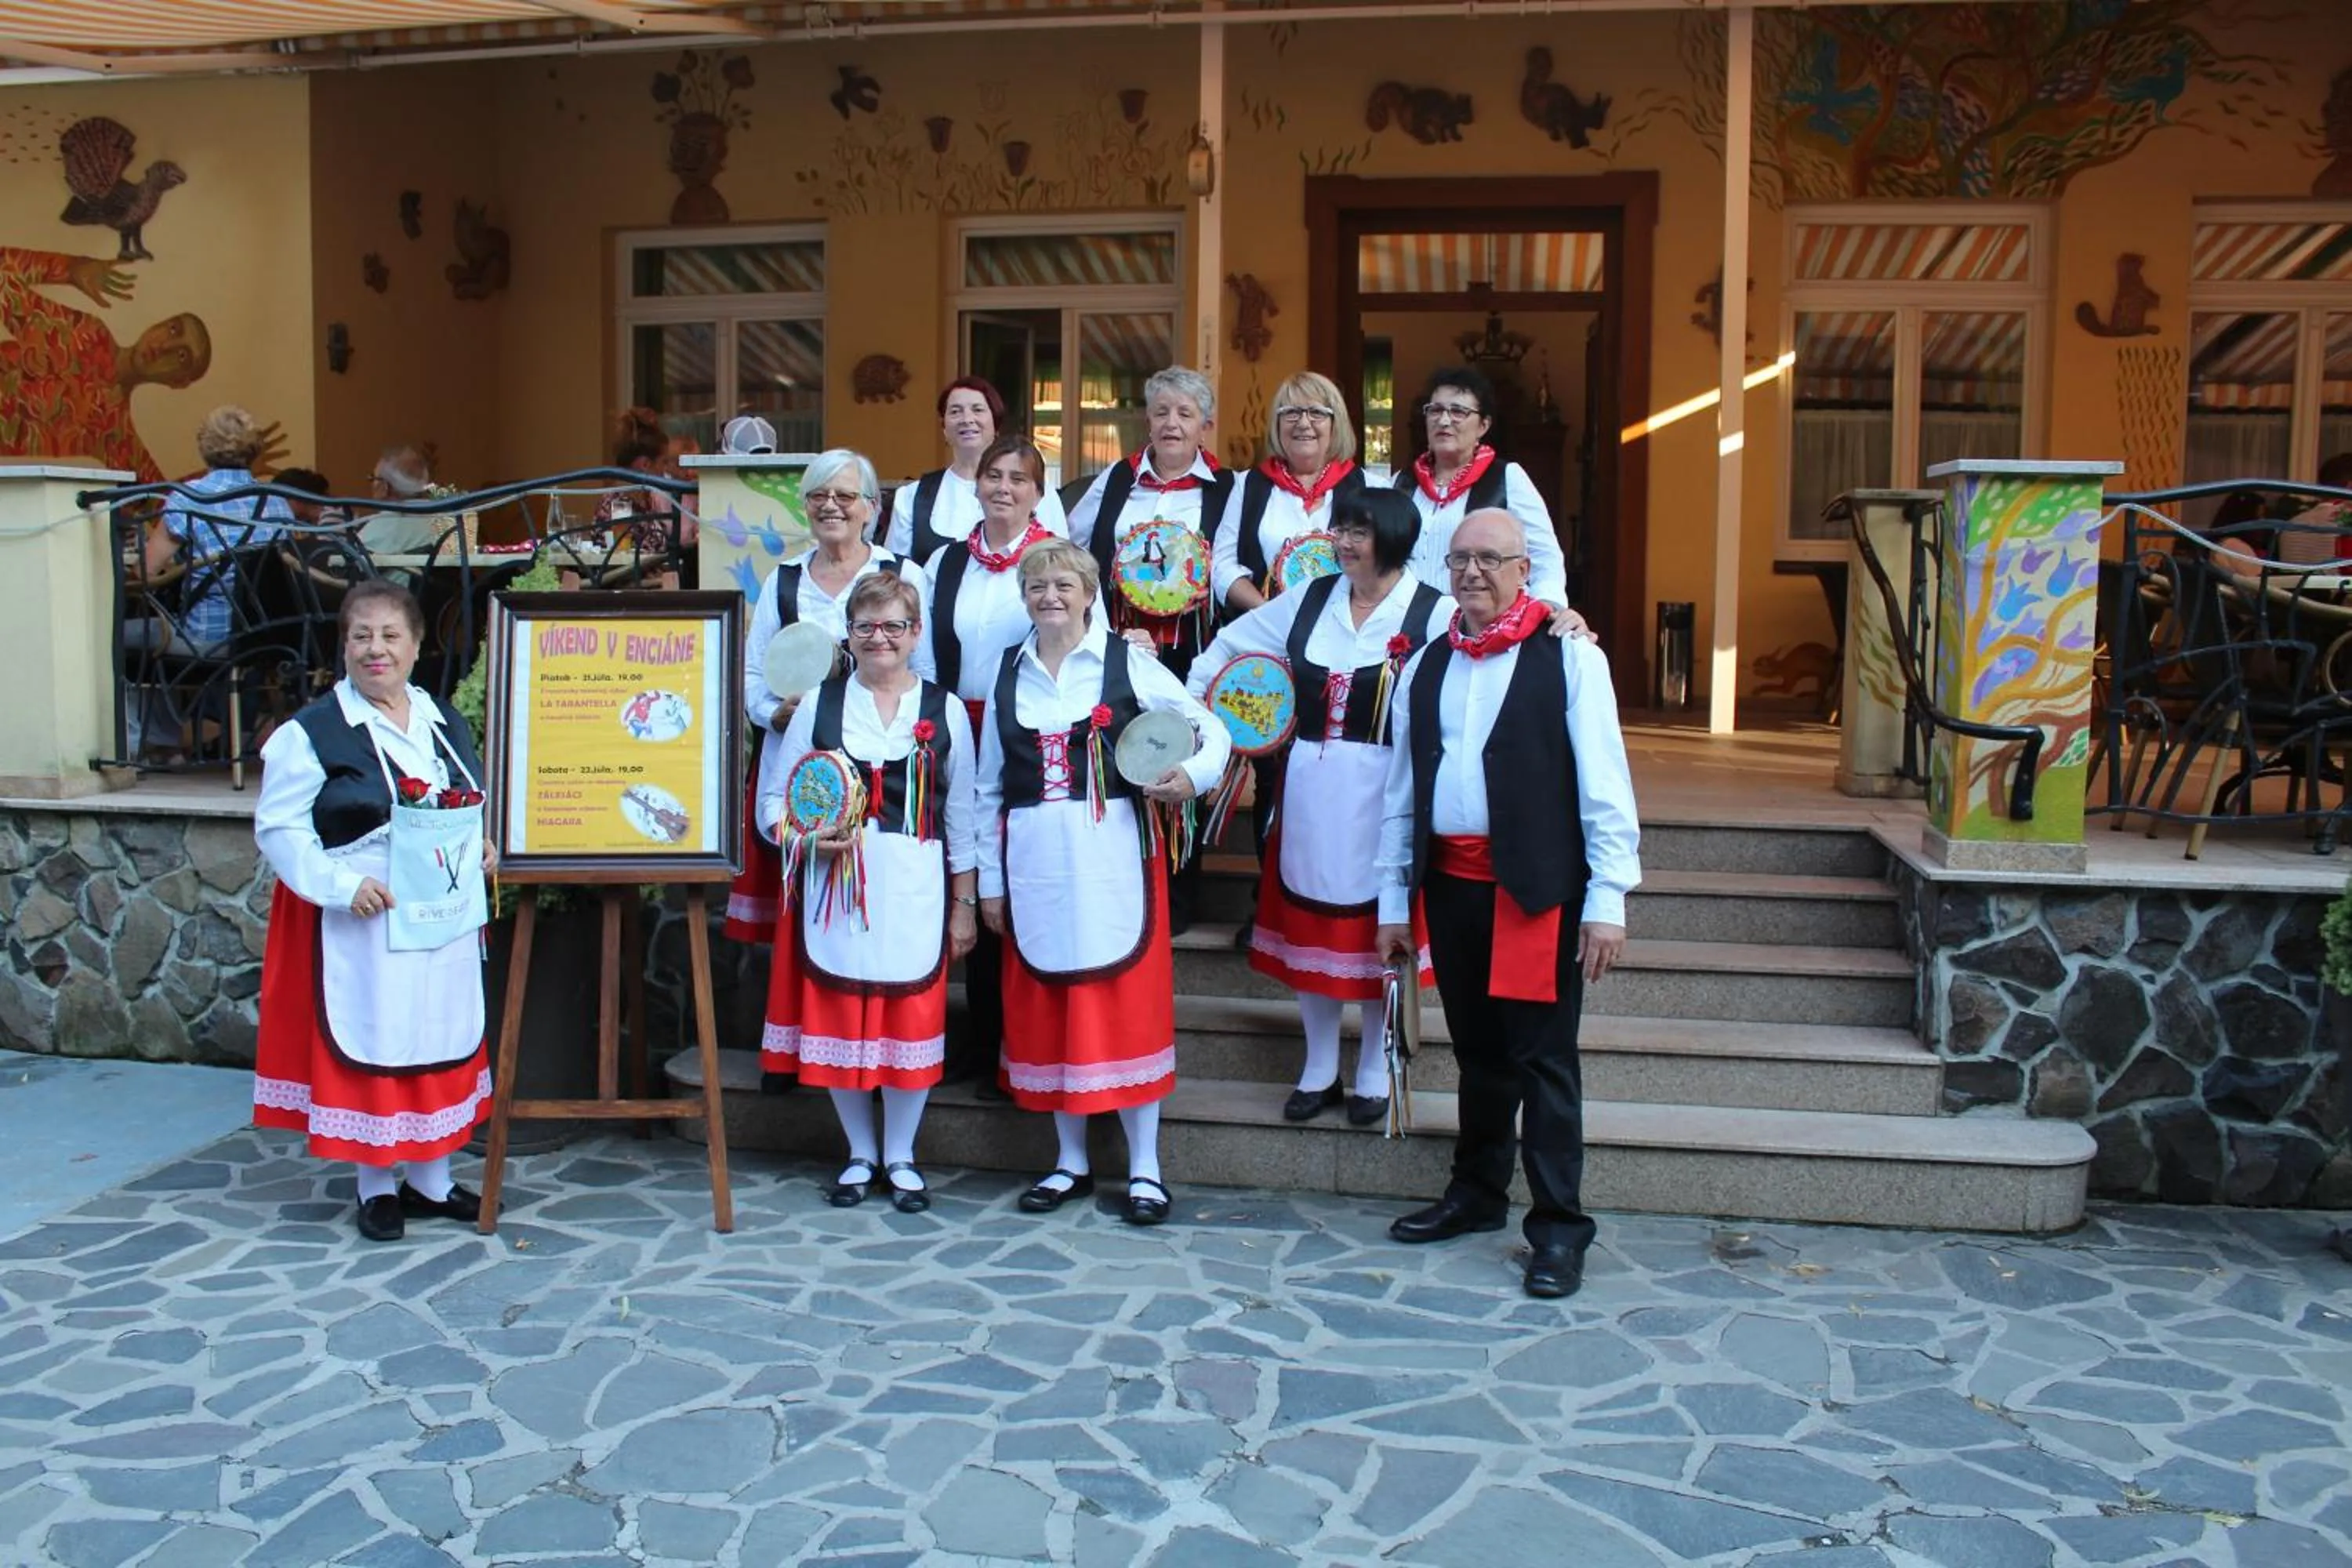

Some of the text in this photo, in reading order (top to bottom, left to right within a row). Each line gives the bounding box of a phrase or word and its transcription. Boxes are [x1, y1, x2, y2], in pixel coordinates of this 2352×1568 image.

[539, 622, 695, 666] VÍKEND V ENCIÁNE
[539, 699, 618, 708] LA TARANTELLA
[537, 817, 583, 826] NIAGARA
